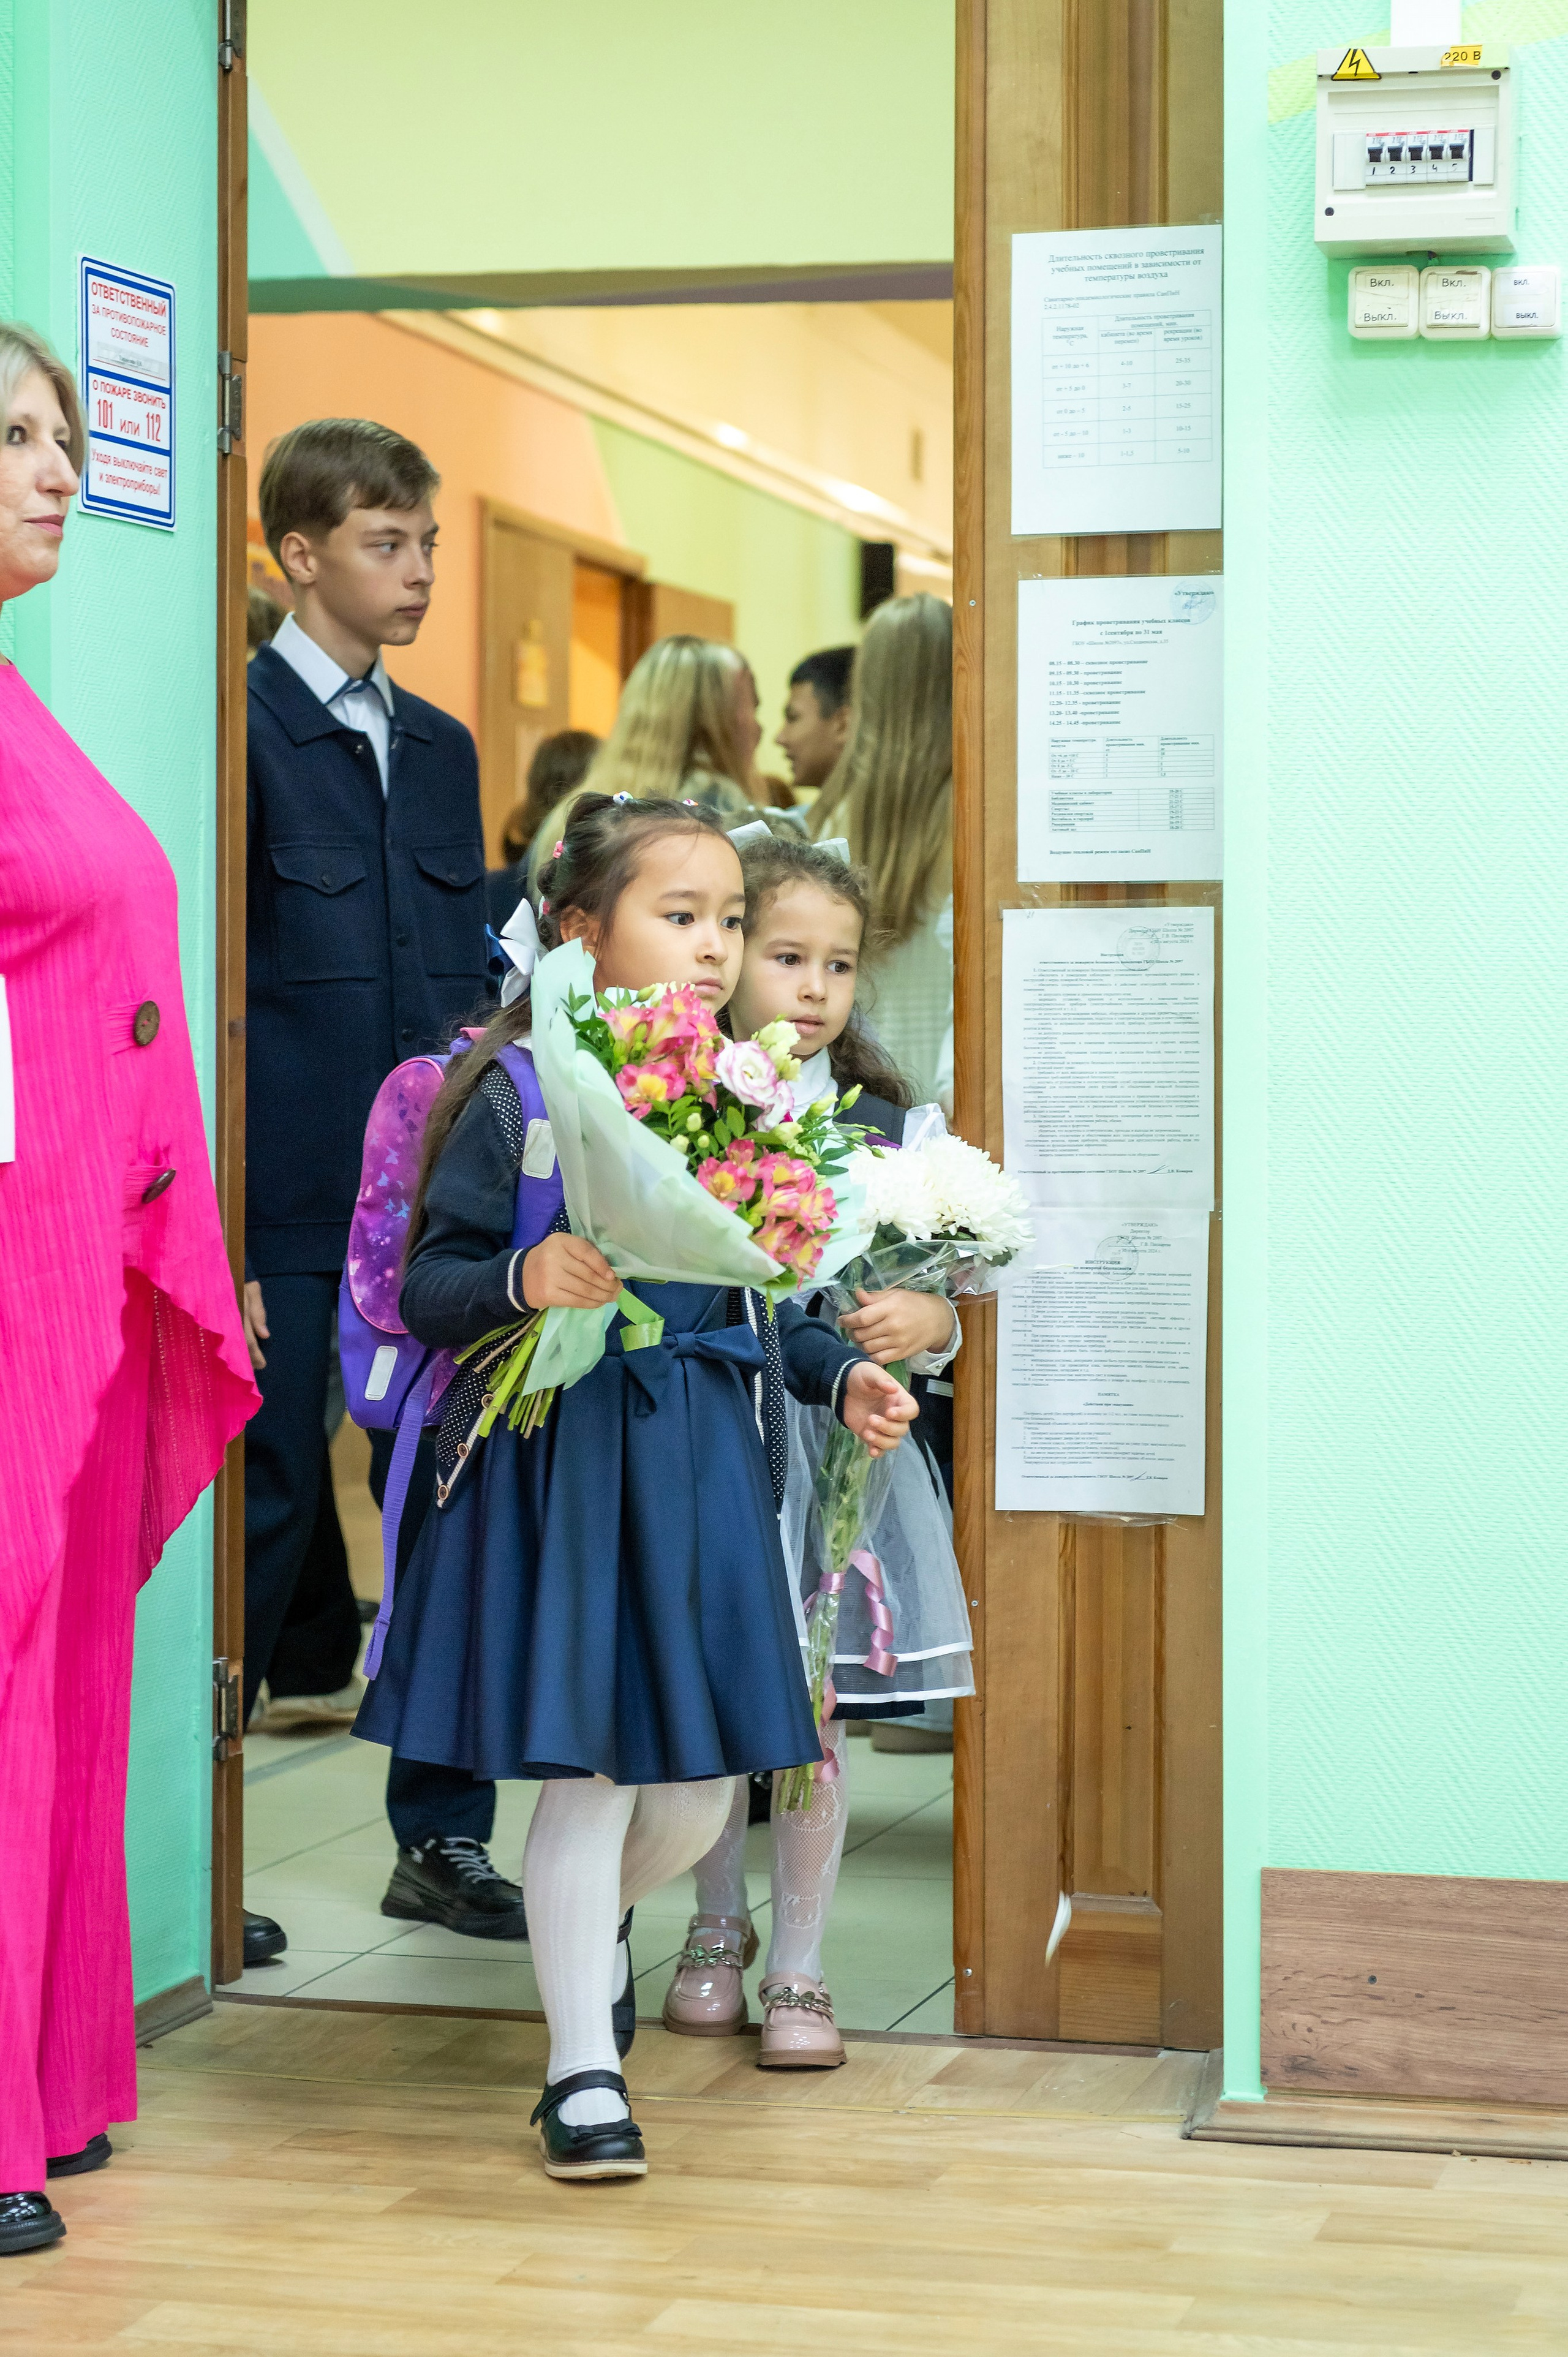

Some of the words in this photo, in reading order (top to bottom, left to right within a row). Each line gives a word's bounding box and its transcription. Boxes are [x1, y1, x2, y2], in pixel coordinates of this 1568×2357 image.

[1444, 51, 1468, 61] 220
[1474, 51, 1480, 60] В
[1049, 254, 1102, 263] Длительность
[1146, 248, 1204, 258] проветривания
[1051, 265, 1085, 274] учебных
[1087, 262, 1132, 271] помещений
[1085, 274, 1135, 282] температуры
[1370, 278, 1395, 287] Вкл.
[1442, 278, 1466, 287] Вкл.
[92, 282, 166, 317] ОТВЕТСТВЕННЫЙ
[92, 304, 100, 315] ЗА
[102, 307, 166, 335] ПРОТИВОПОЖАРНОЕ
[1363, 313, 1397, 322] Выкл.
[1434, 311, 1467, 320] Выкл.
[111, 328, 148, 347] СОСТОЯНИЕ
[93, 380, 98, 390] О
[100, 382, 131, 399] ПОЖАРЕ
[134, 391, 166, 409] ЗВОНИТЬ
[97, 399, 113, 429] 101
[146, 412, 160, 442] 112
[113, 456, 153, 475] выключайте
